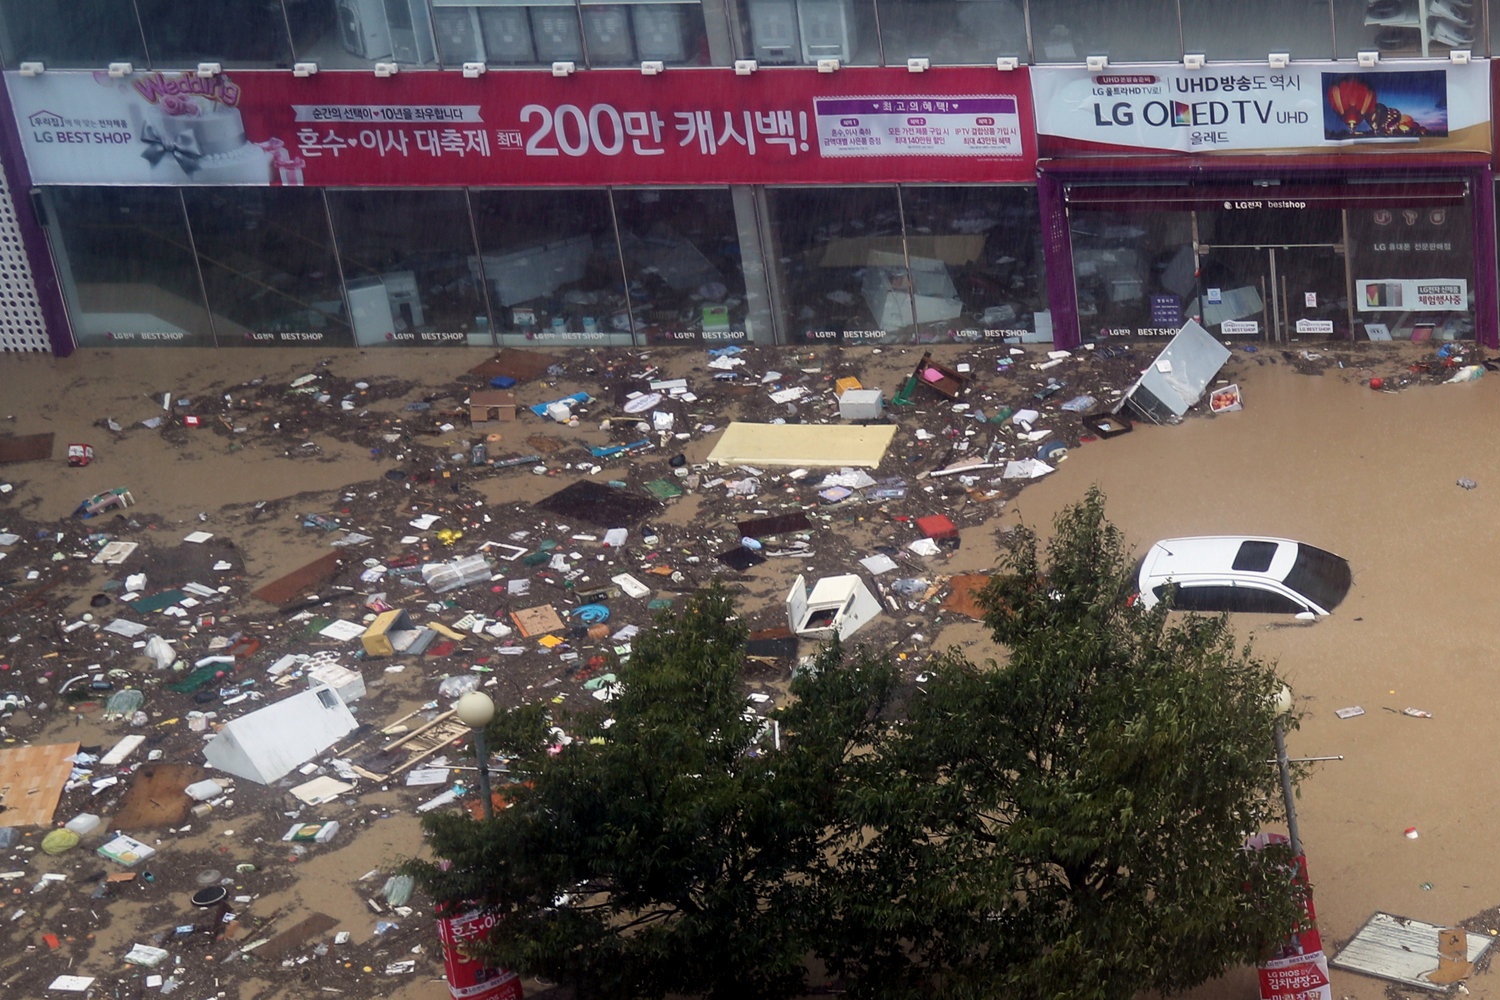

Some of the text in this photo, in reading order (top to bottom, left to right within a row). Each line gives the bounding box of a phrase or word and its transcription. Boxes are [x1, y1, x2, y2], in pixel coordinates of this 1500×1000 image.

[136, 73, 240, 106] Wedding
[1269, 74, 1301, 91] 역시
[1092, 87, 1104, 96] LG
[312, 106, 463, 120] 순간의 선택이 10년을 좌우합니다
[1093, 99, 1309, 127] LG OLED TV UHD
[296, 103, 811, 158] 혼수 이사 대축제 최대 200만 캐시백!
[33, 131, 132, 145] LG BEST SHOP
[1190, 131, 1230, 145] 올레드
[1234, 200, 1263, 210] LG전자
[1373, 243, 1387, 251] LG
[562, 332, 604, 340] BEST SHOP
[844, 331, 863, 339] BEST
[865, 331, 886, 339] SHOP
[1279, 970, 1300, 978] DIOS
[1268, 974, 1322, 990] 김치냉장고
